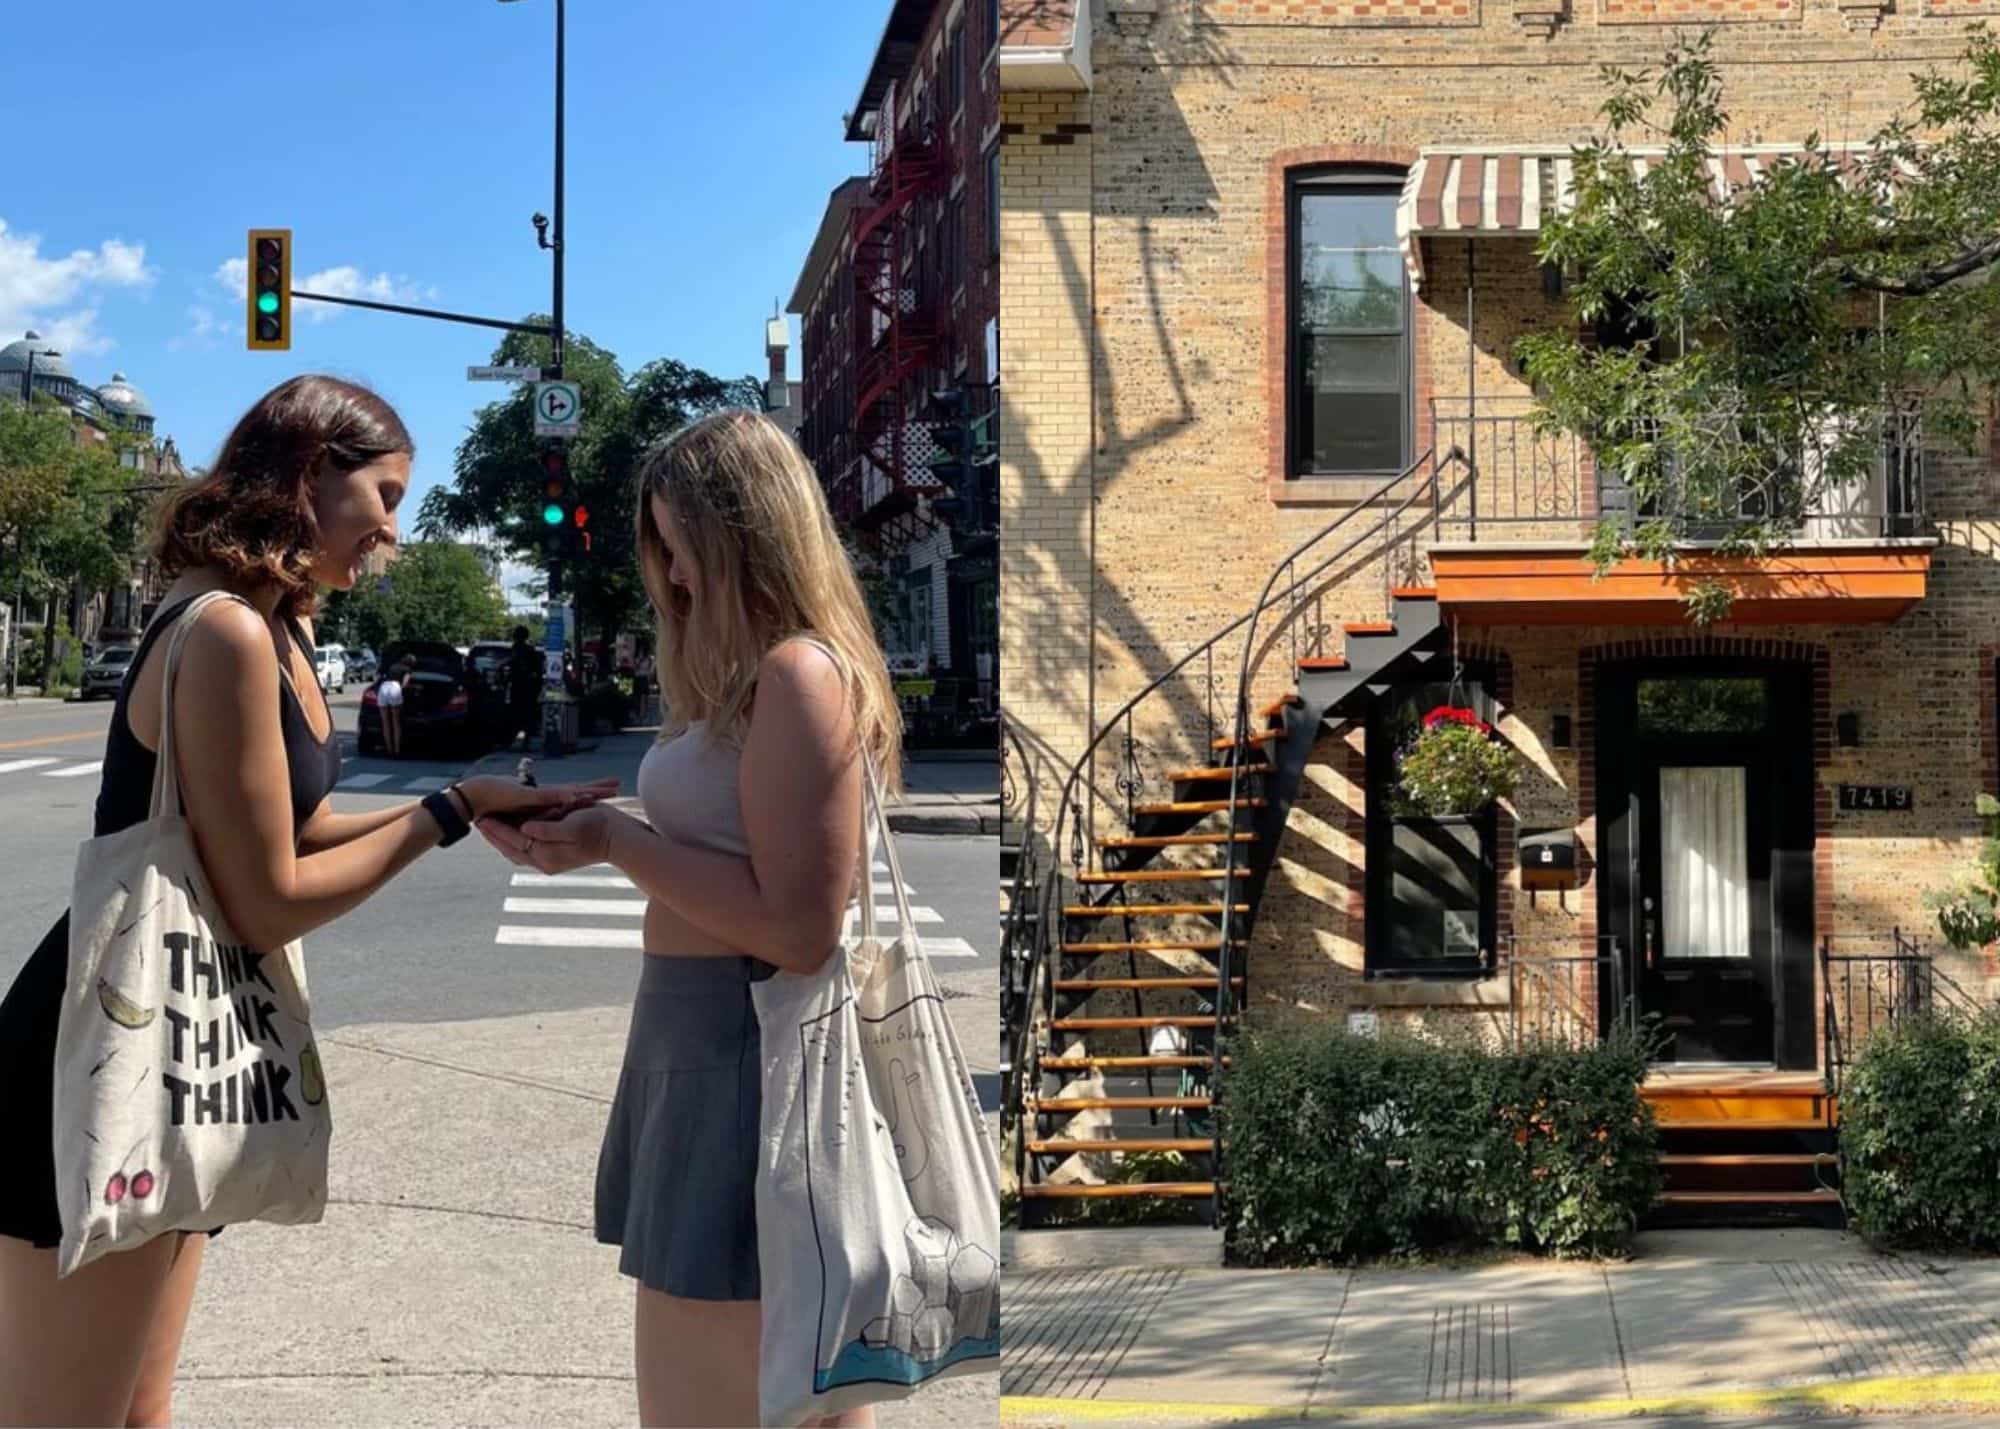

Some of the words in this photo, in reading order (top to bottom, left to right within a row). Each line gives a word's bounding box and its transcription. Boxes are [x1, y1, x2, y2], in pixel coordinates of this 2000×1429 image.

[1846, 787, 1907, 807] 7419
[164, 932, 276, 1000] THINK
[164, 995, 285, 1069] THINK
[163, 1059, 300, 1126] THINK
